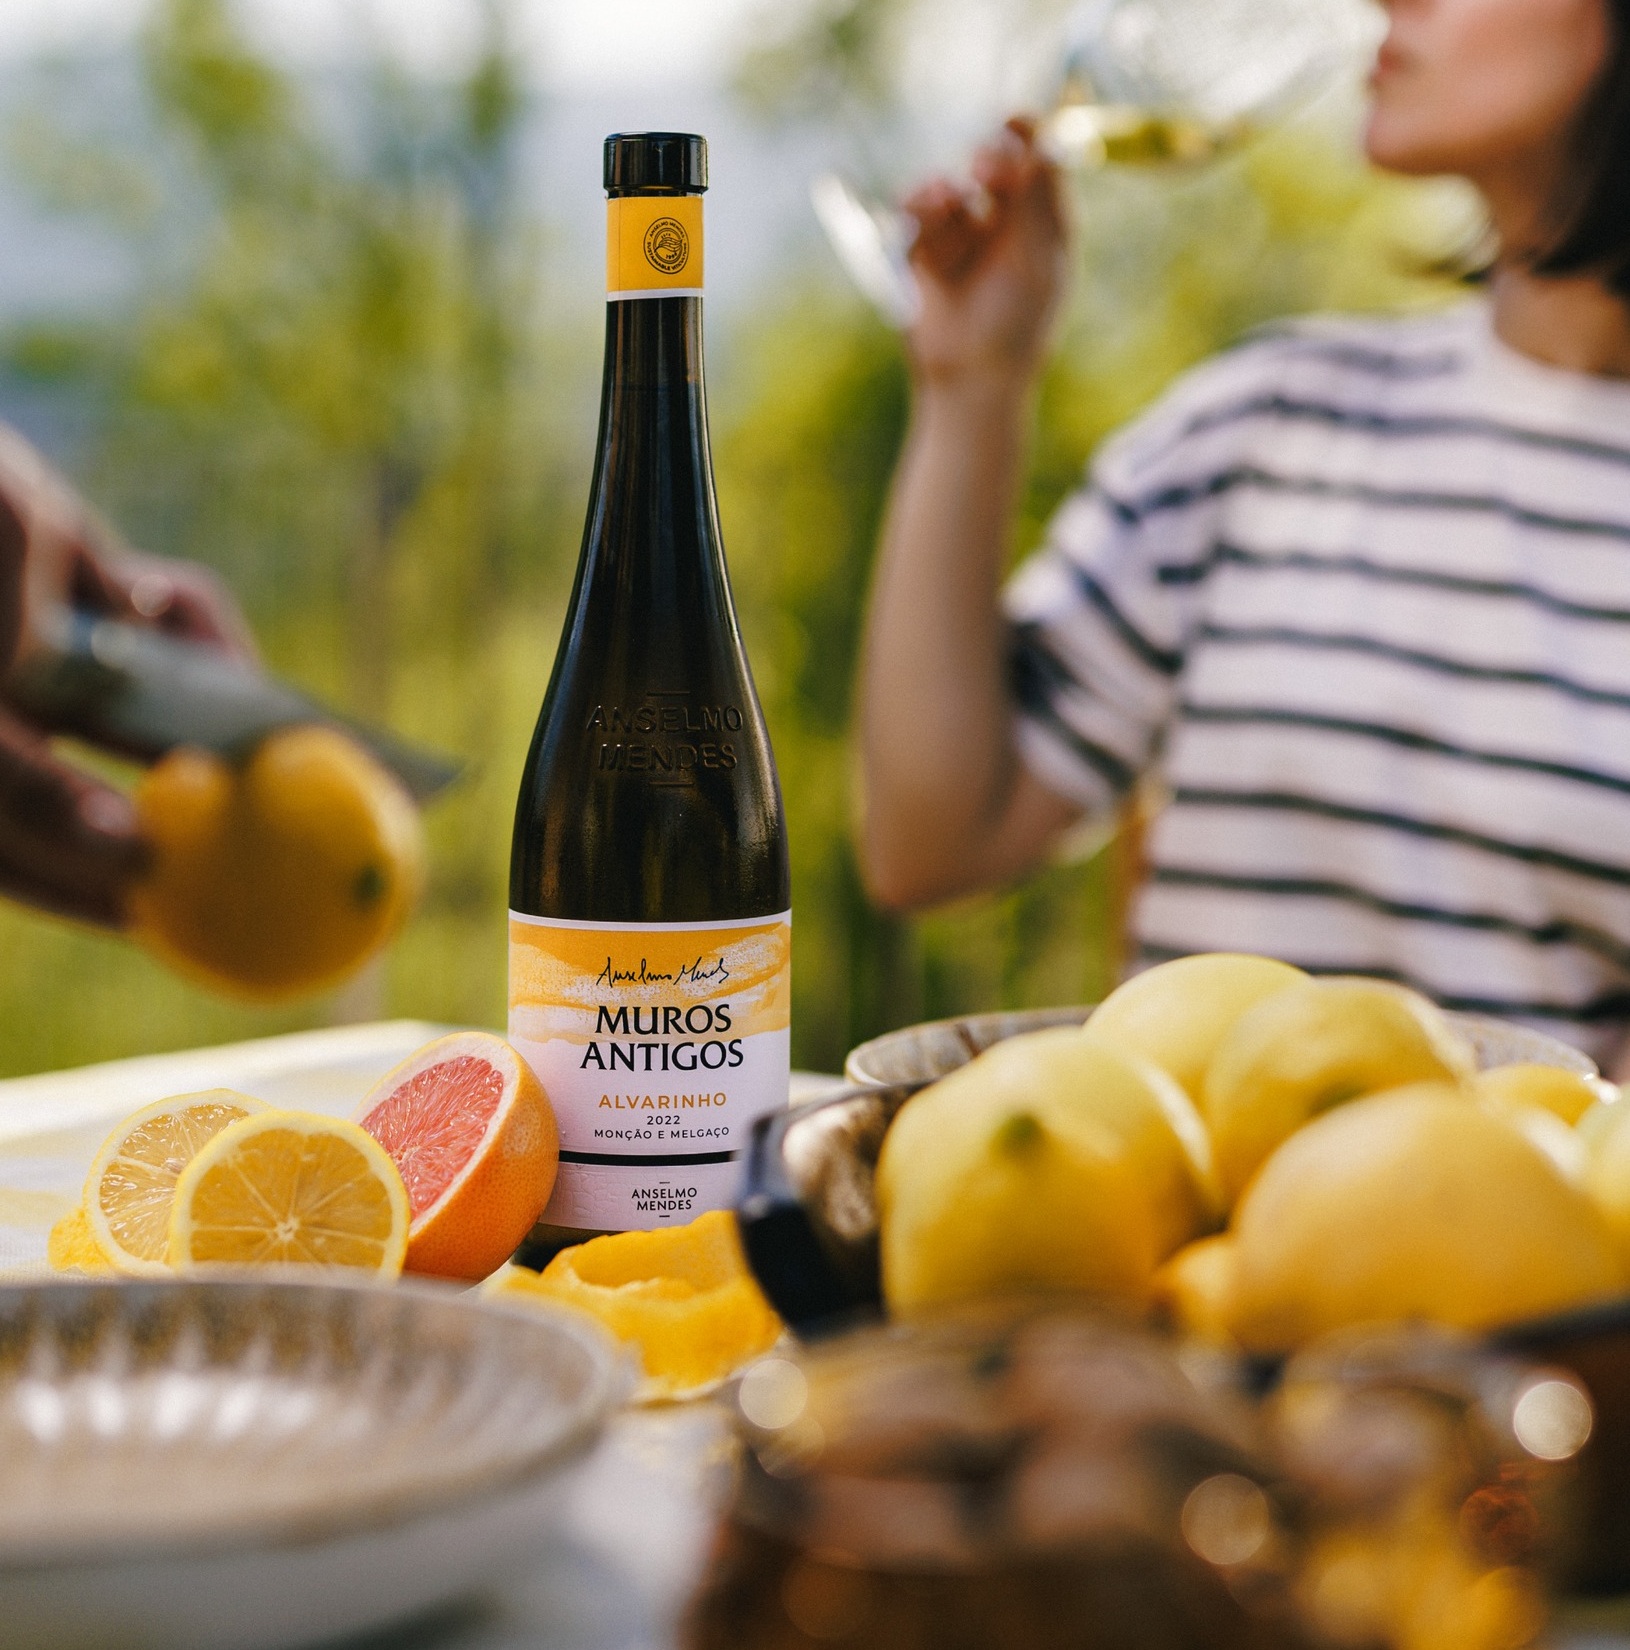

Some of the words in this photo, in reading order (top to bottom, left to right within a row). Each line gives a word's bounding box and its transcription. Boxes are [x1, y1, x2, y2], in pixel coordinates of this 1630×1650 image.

[650, 221, 668, 238] ANSELMO
[586, 705, 743, 733] ANSELMO
[599, 744, 737, 771] MENDES
[595, 1003, 732, 1035] MUROS
[579, 1039, 744, 1072] ANTIGOS
[598, 1092, 727, 1109] ALVARINHO
[646, 1115, 681, 1126] 2022
[594, 1129, 652, 1141] MONÇÃO
[658, 1130, 665, 1139] E
[670, 1126, 730, 1139] MELGAÇO
[631, 1187, 698, 1199] ANSELMO
[636, 1200, 692, 1211] MENDES
